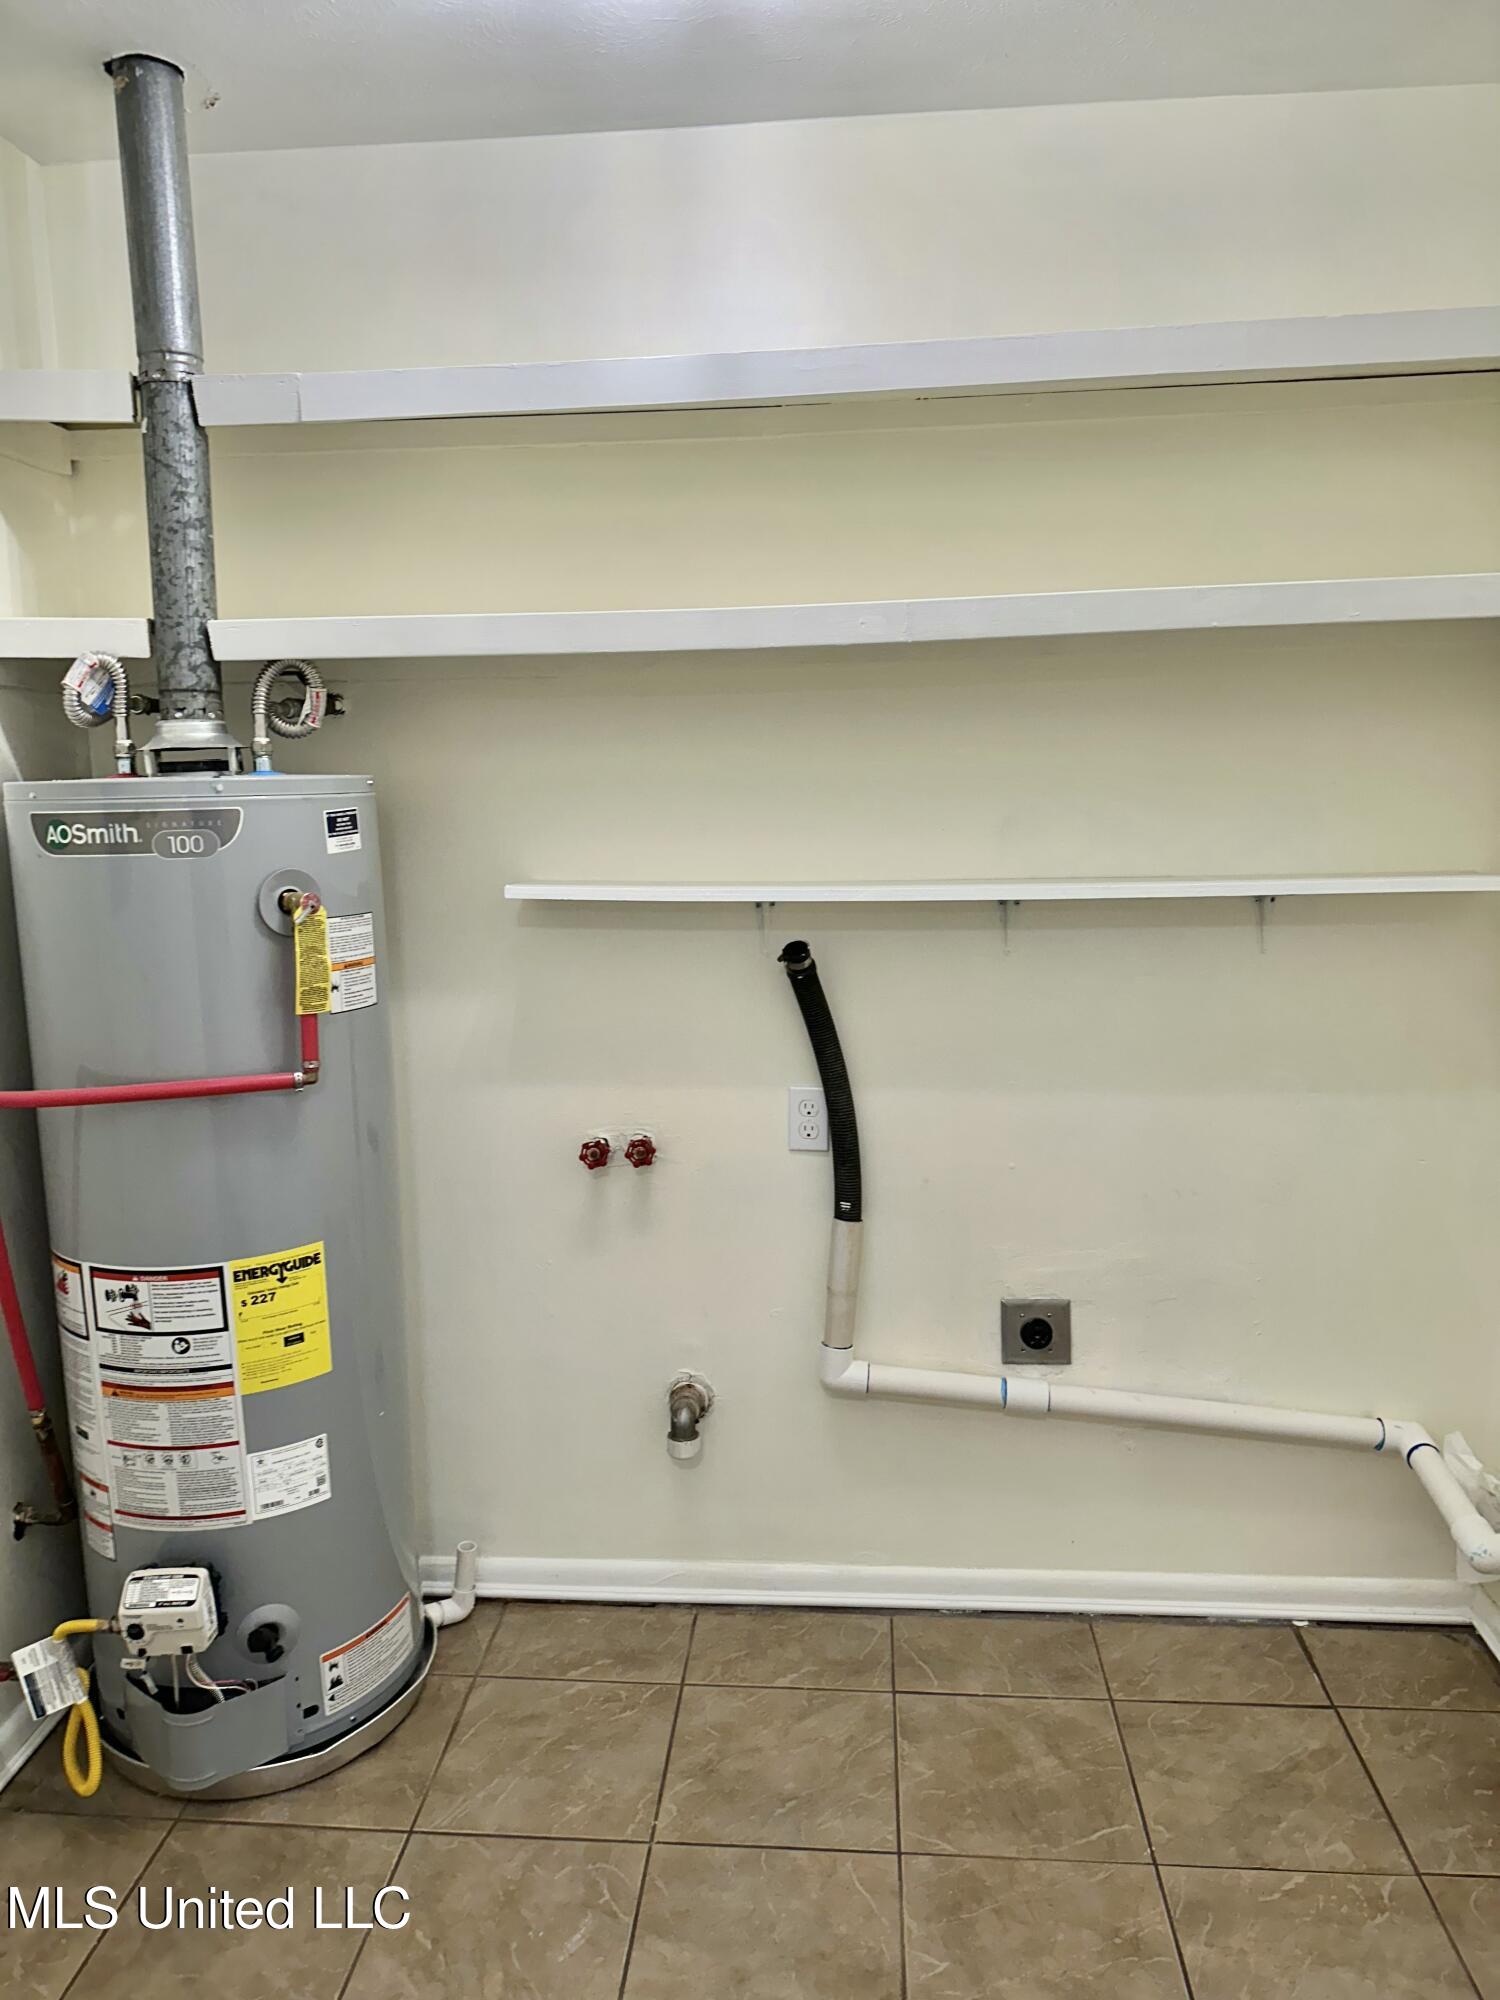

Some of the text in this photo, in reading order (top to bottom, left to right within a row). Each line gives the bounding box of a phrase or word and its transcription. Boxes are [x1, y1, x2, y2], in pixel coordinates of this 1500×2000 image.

[46, 823, 138, 844] AOSmith
[167, 835, 204, 854] 100
[250, 1292, 277, 1306] 227
